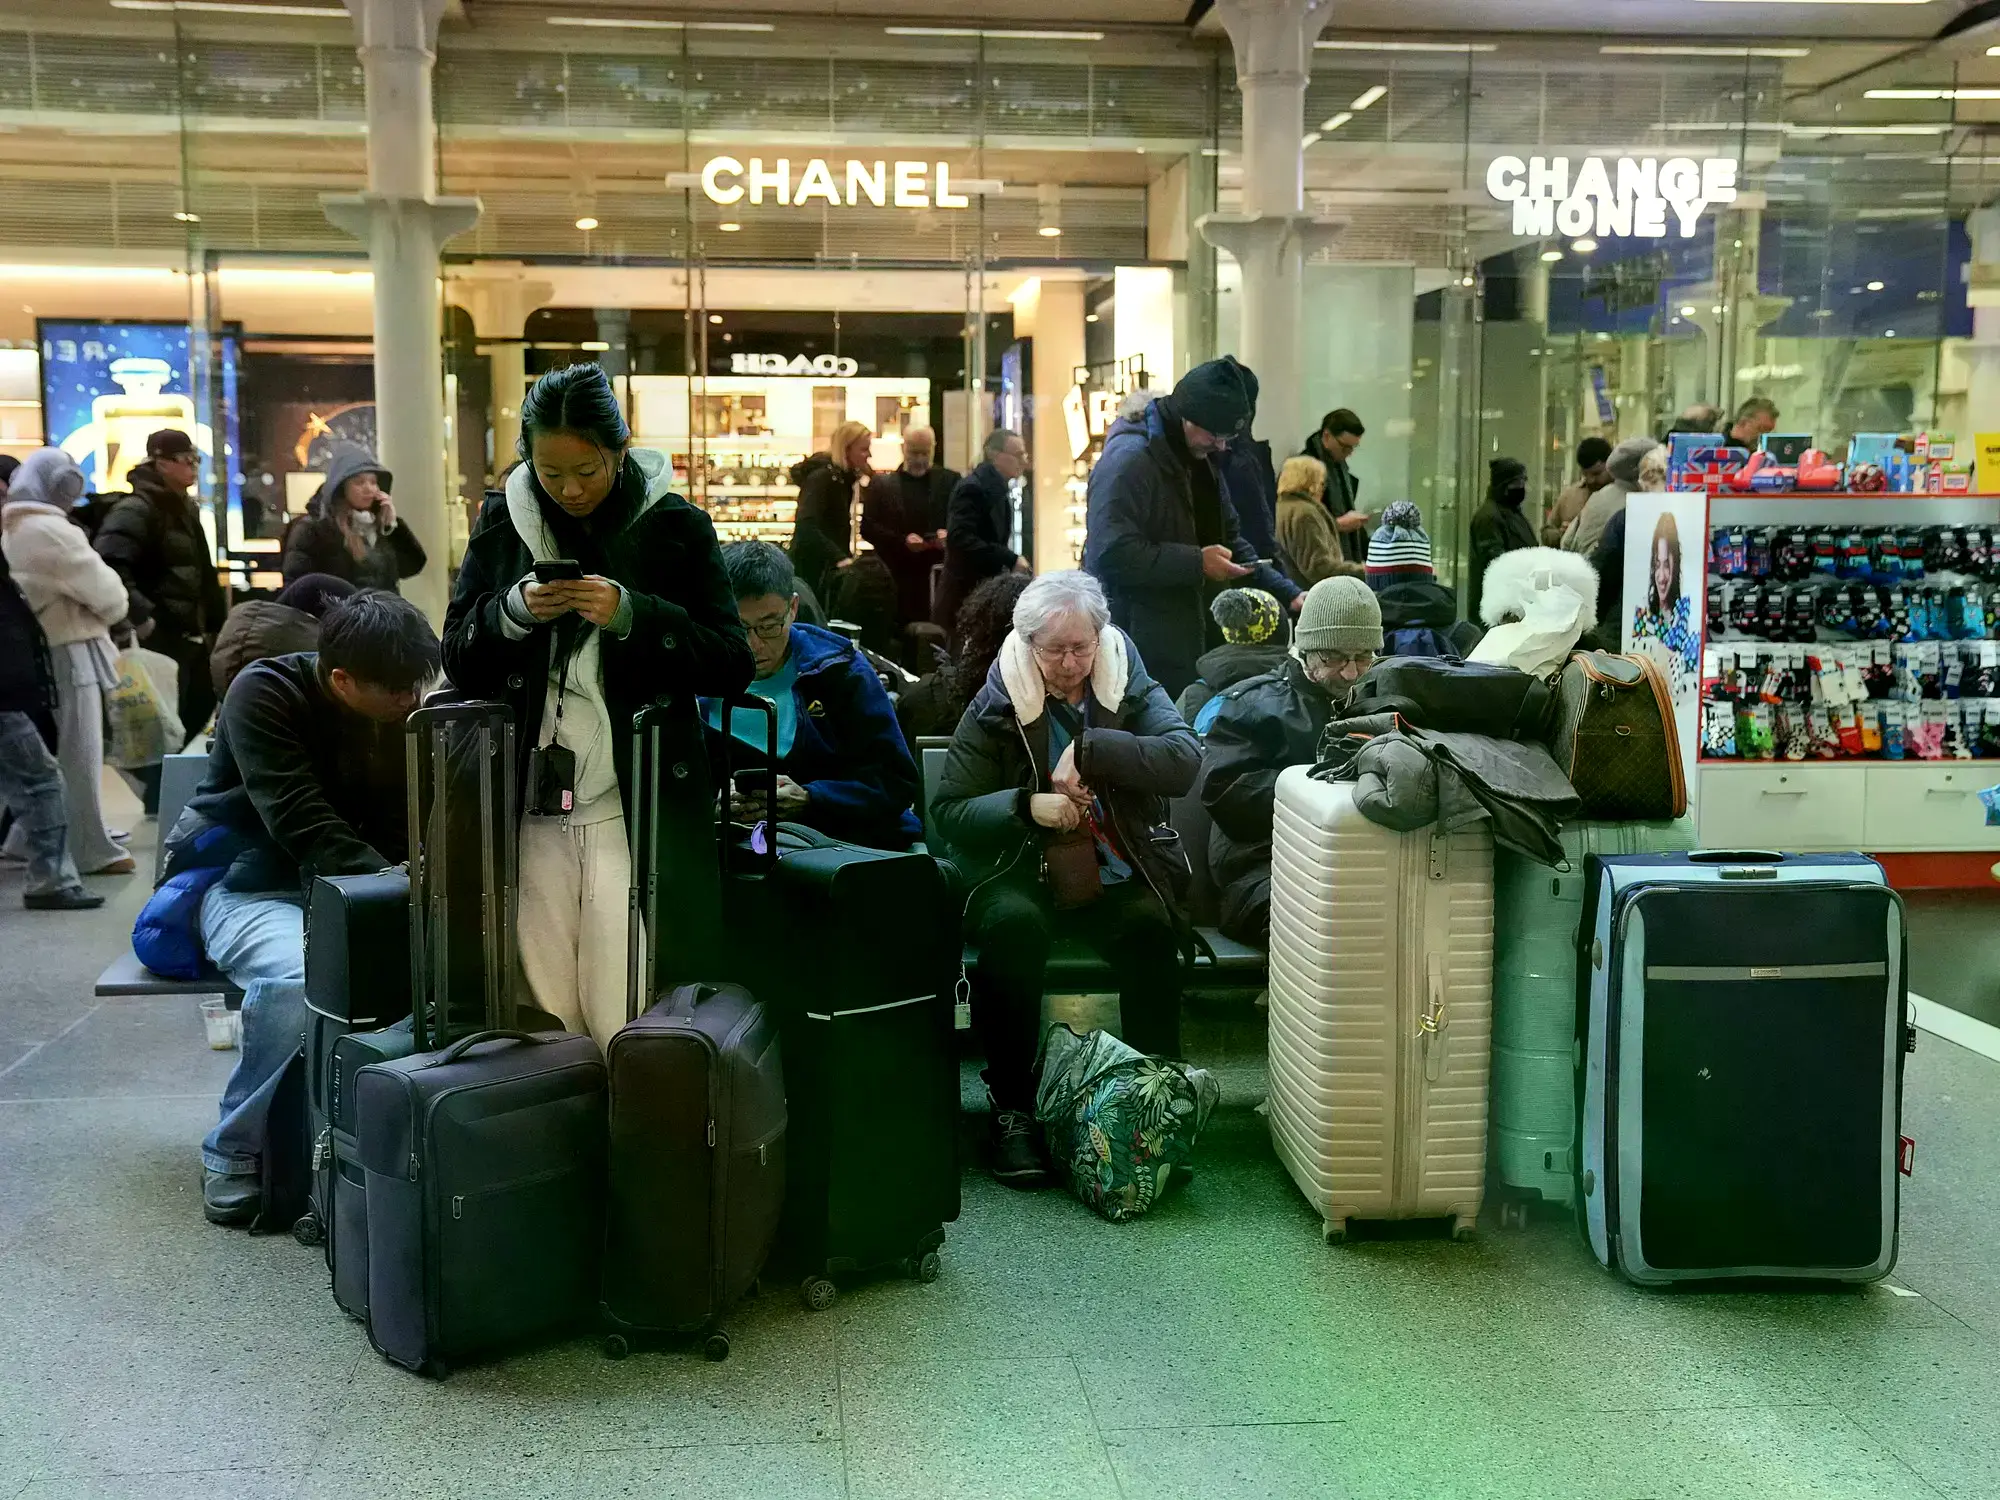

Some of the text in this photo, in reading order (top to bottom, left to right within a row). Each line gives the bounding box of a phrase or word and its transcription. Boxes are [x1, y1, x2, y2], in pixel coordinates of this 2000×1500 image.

[701, 156, 969, 208] CHANEL
[1486, 155, 1738, 203] CHANGE
[1512, 197, 1710, 238] MONEY
